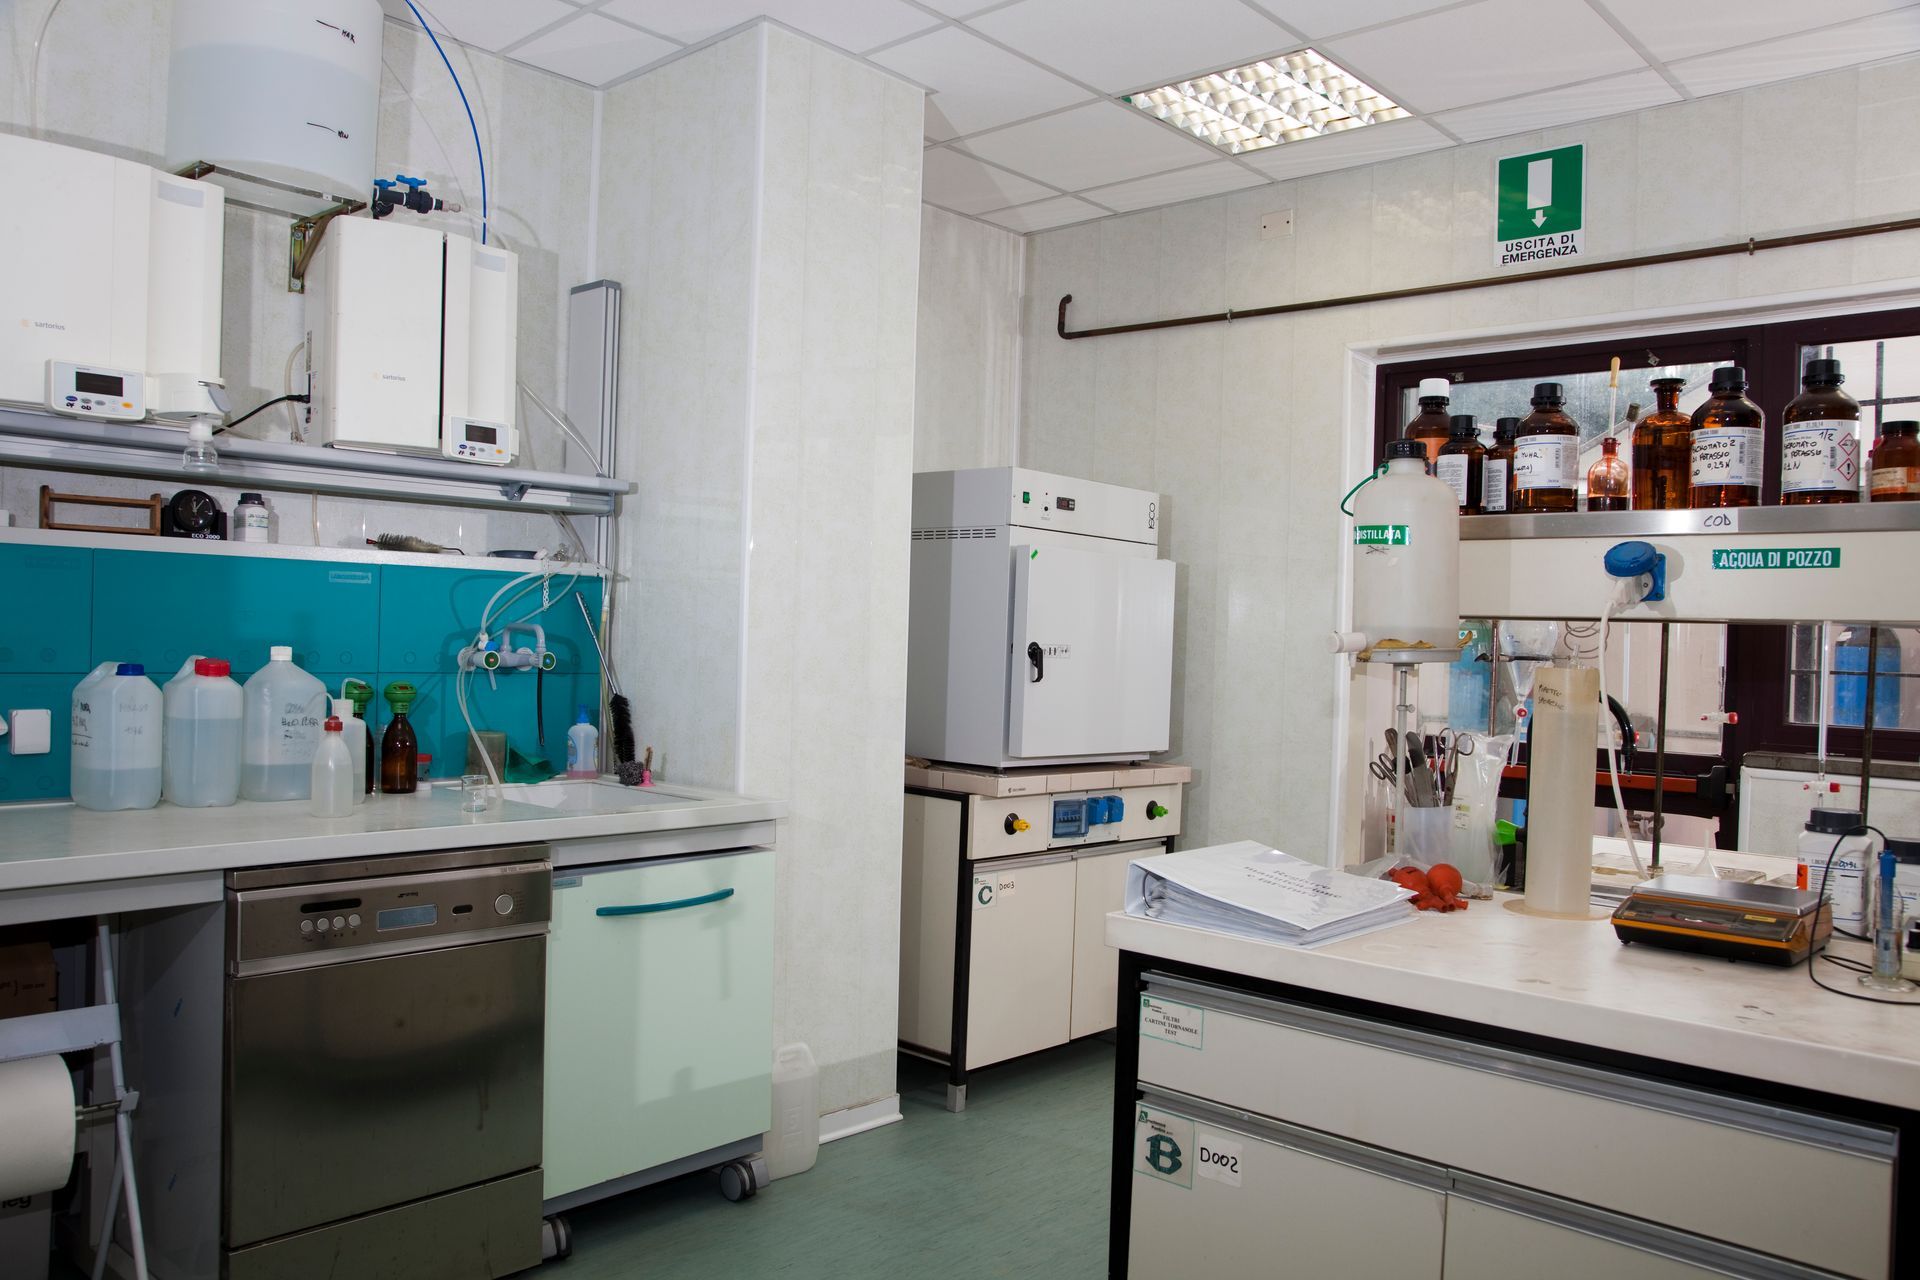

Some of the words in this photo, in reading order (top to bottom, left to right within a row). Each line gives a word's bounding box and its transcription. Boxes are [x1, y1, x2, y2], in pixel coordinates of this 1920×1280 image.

[1505, 237, 1555, 253] USCITA
[1560, 233, 1574, 244] DI
[1501, 244, 1578, 264] EMERGENZA
[34, 320, 66, 331] sartorius
[381, 374, 406, 382] sartorius
[1703, 513, 1732, 527] COD
[1720, 551, 1764, 568] ACQUA
[1767, 551, 1781, 567] DI
[1786, 550, 1833, 567] POZZO
[998, 880, 1015, 891] D003
[977, 885, 993, 905] C
[1144, 1017, 1168, 1027] CARTINE
[1167, 1022, 1199, 1035] TORNASOLE
[1162, 1014, 1180, 1024] FILTRI
[1164, 1028, 1177, 1036] TEST
[1145, 1133, 1183, 1175] B
[1200, 1146, 1239, 1173] D002
